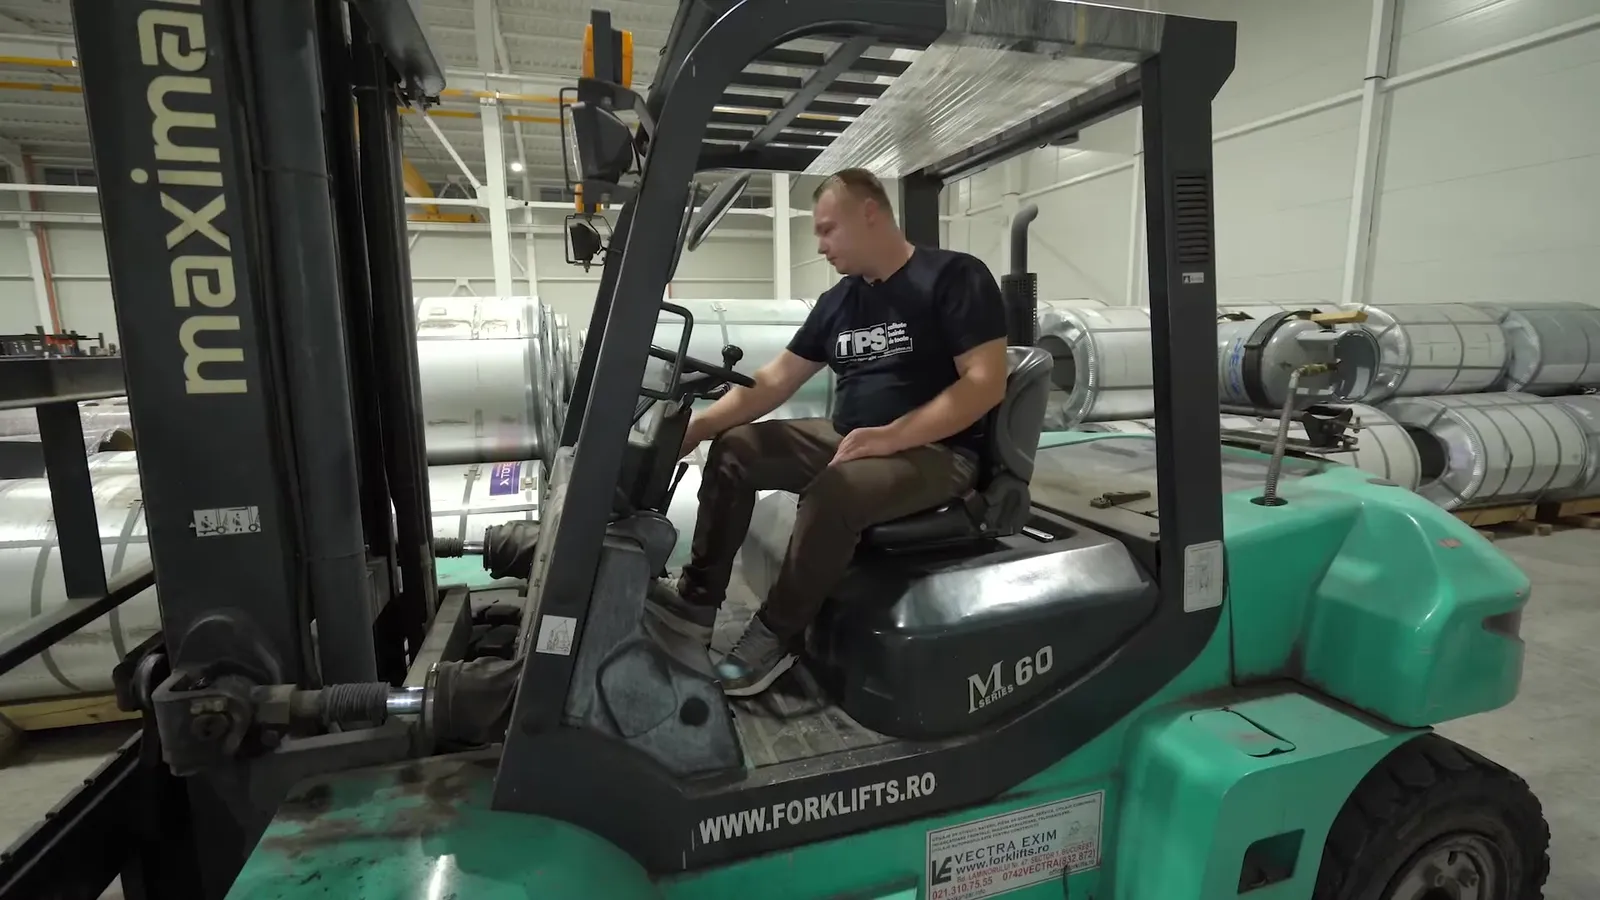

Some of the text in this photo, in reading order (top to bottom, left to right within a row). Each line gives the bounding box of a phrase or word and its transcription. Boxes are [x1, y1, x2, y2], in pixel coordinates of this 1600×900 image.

[967, 645, 1053, 714] M 60
[978, 684, 1014, 708] SERIES
[699, 772, 936, 844] WWW.FORKLIFTS.RO
[954, 841, 1016, 865] VECTRA
[1022, 829, 1057, 848] EXIM
[956, 844, 1050, 874] www.forklifts.ro
